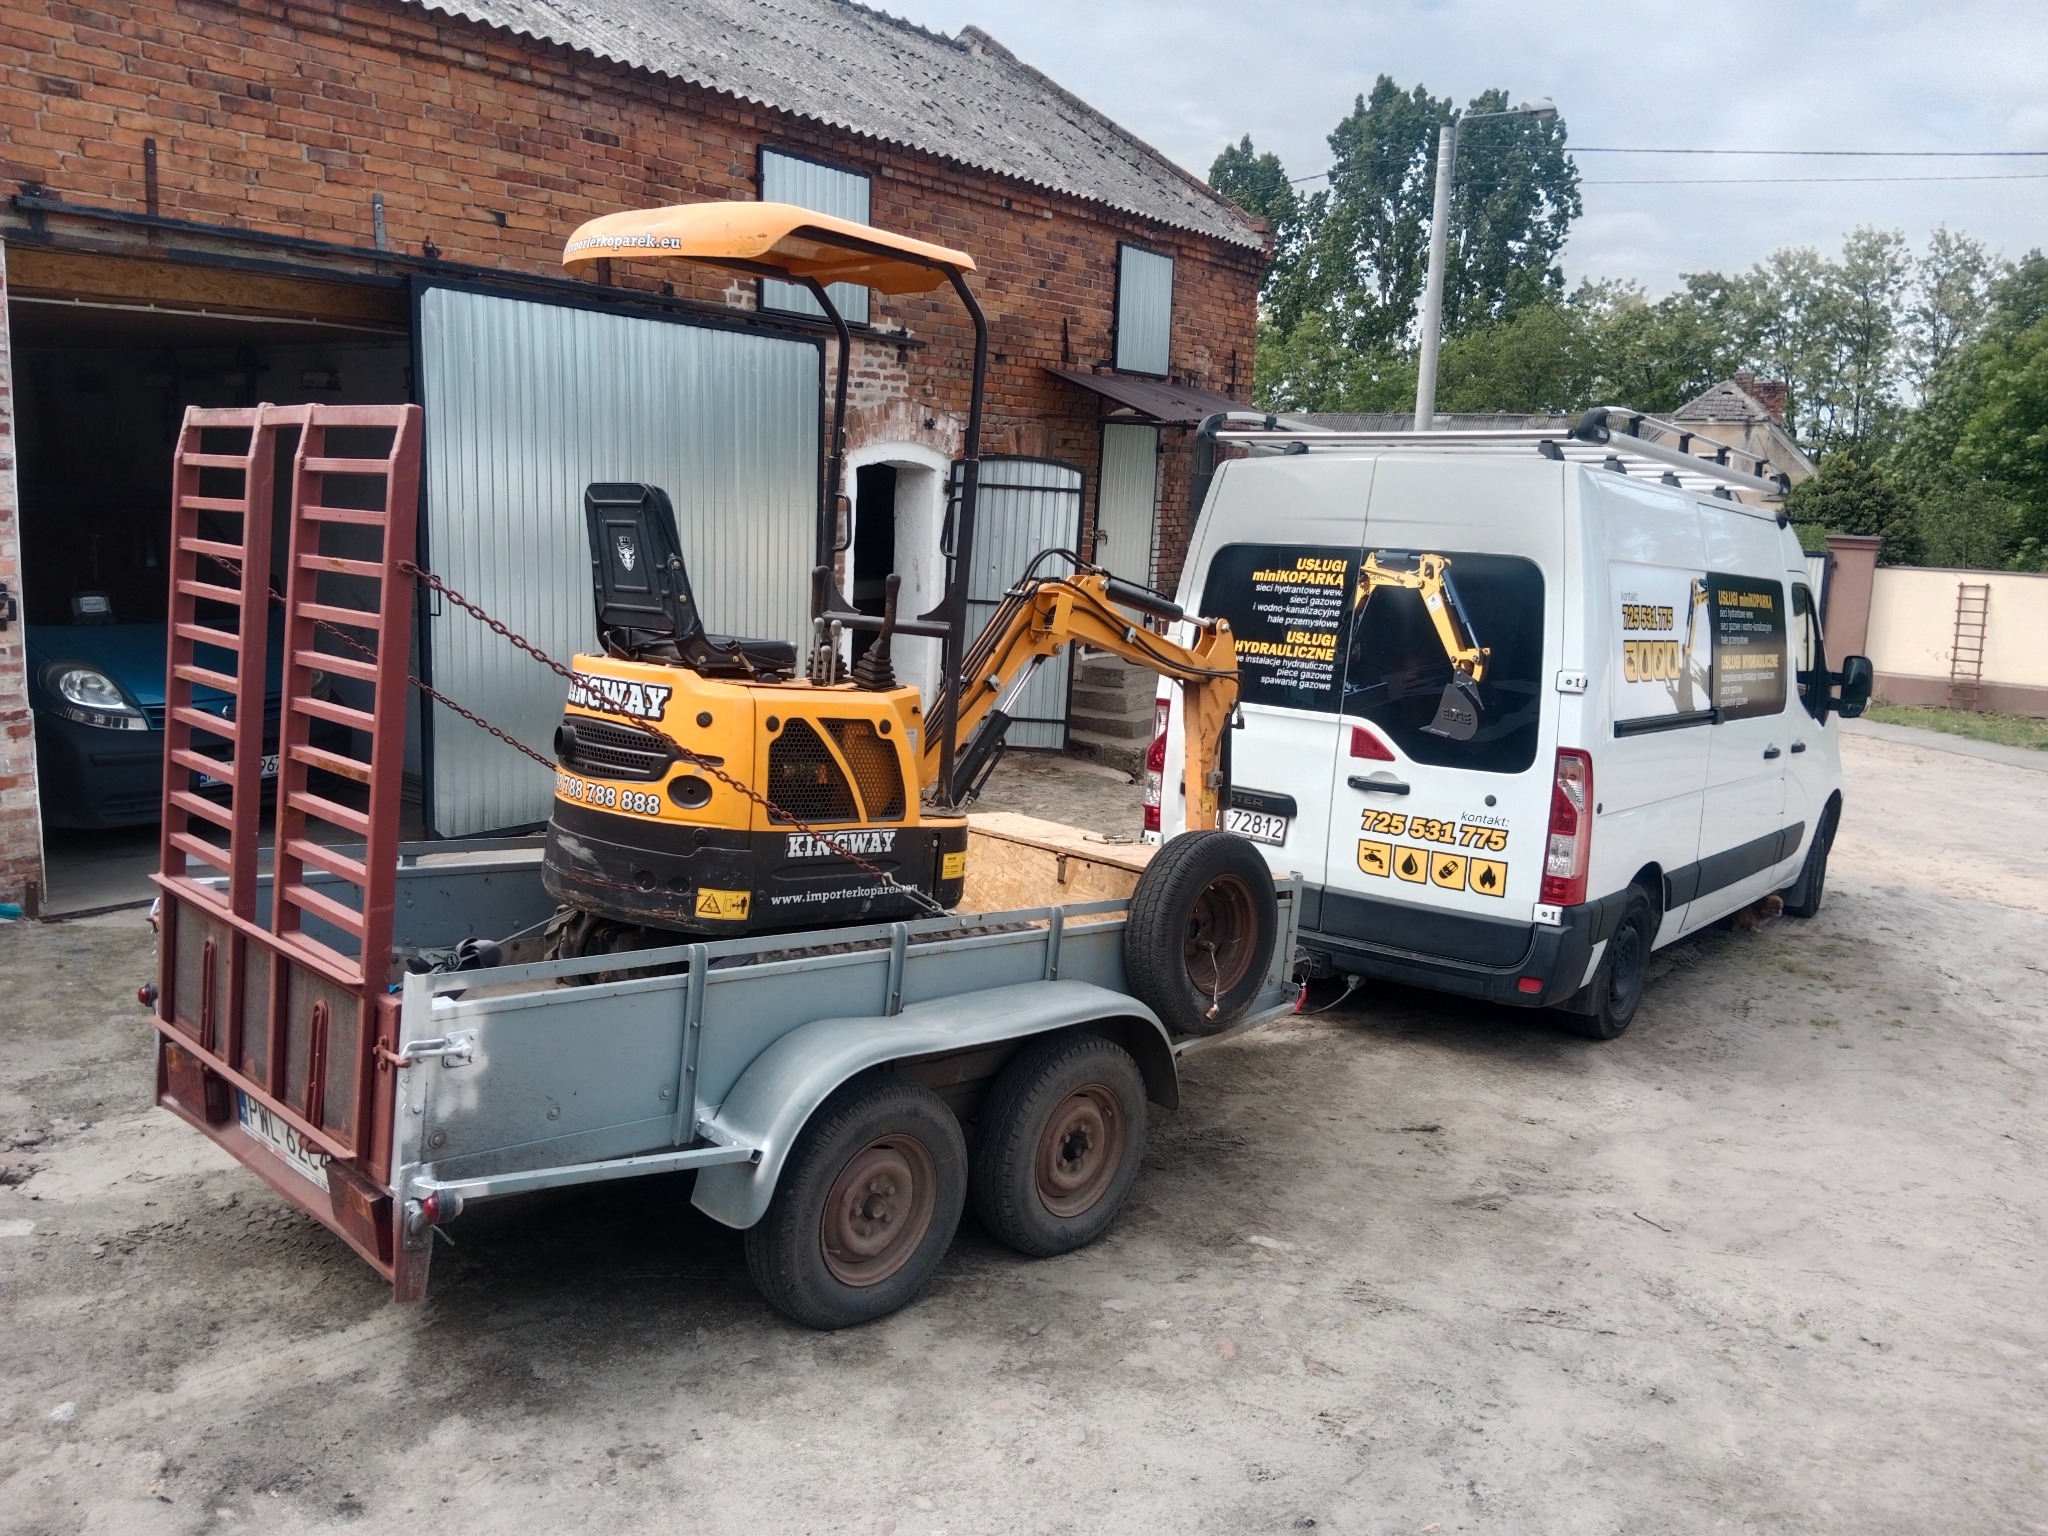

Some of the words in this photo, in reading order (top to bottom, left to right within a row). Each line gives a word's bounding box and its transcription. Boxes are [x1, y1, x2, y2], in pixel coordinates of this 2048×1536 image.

[1296, 558, 1348, 573] USŁUGI
[1252, 569, 1344, 589] miniKOPARKĄ
[1256, 583, 1274, 592] sieci
[1274, 584, 1321, 595] hydrantowe
[1322, 588, 1344, 597] wew.
[1290, 595, 1309, 604] sieci
[1309, 598, 1342, 607] gazowe
[1252, 602, 1257, 610] i
[1257, 603, 1340, 618] wodno-kanalizacyjne
[1622, 603, 1640, 631] 725
[1641, 604, 1658, 631] 531
[1658, 605, 1673, 631] 775
[1267, 614, 1284, 624] hale
[1284, 617, 1339, 628] przemysłowe
[1286, 630, 1338, 647] USŁUGI
[1234, 640, 1336, 661] HYDRAULICZNE
[1245, 654, 1282, 668] instalacje
[1282, 658, 1334, 671] hydrauliczne
[1260, 675, 1298, 687] spawanie
[1298, 680, 1332, 691] gazowe
[1276, 668, 1299, 677] piece
[1299, 671, 1333, 681] gazowe
[564, 775, 583, 799] 788
[586, 781, 617, 807] 788
[620, 789, 660, 815] 888
[1231, 793, 1264, 807] STER
[1231, 810, 1284, 839] 72812
[1460, 811, 1510, 827] kontakt:
[1361, 808, 1408, 836] 725
[1408, 816, 1457, 845] 531
[1459, 824, 1509, 852] 775
[787, 830, 897, 858] KINGWAY
[771, 883, 918, 905] www.importerkopareku
